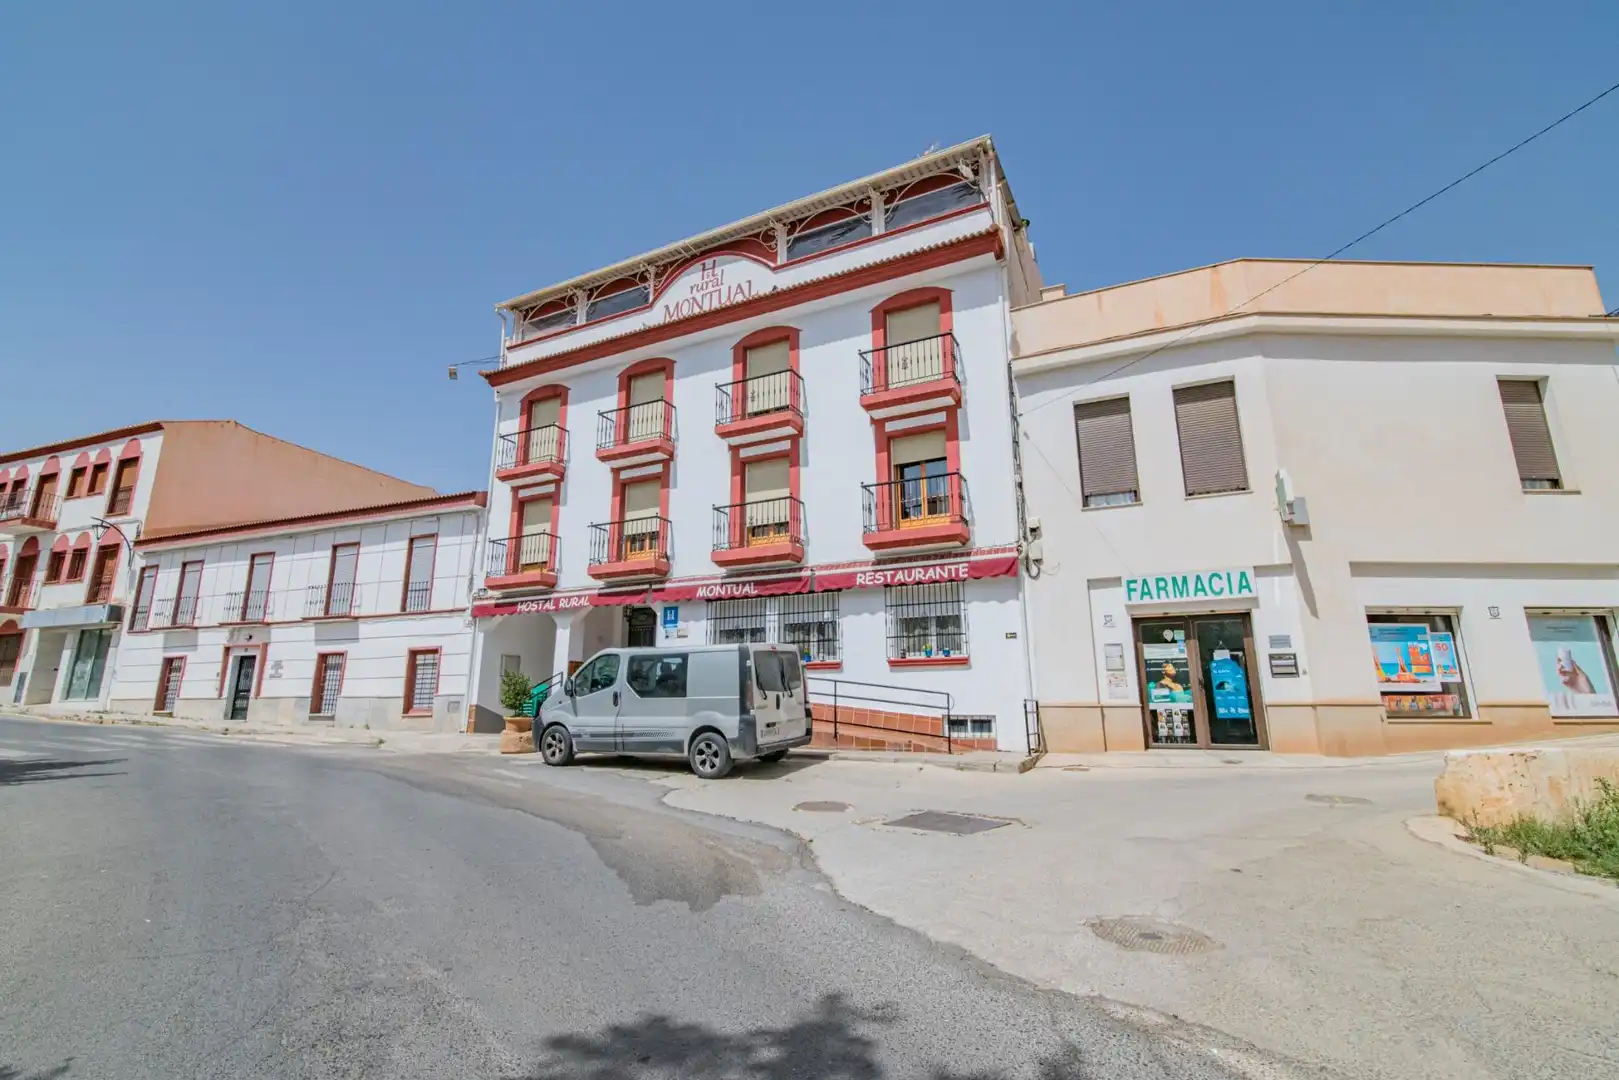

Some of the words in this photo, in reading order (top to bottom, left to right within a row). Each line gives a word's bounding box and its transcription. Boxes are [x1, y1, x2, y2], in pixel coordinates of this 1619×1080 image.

[690, 269, 724, 294] rural
[856, 563, 969, 586] RESTAURANTE
[696, 582, 758, 598] MONTUAL
[1126, 571, 1252, 601] FARMACIA
[516, 600, 555, 613] HOSTAL
[558, 595, 590, 609] RURAL
[667, 609, 675, 620] H
